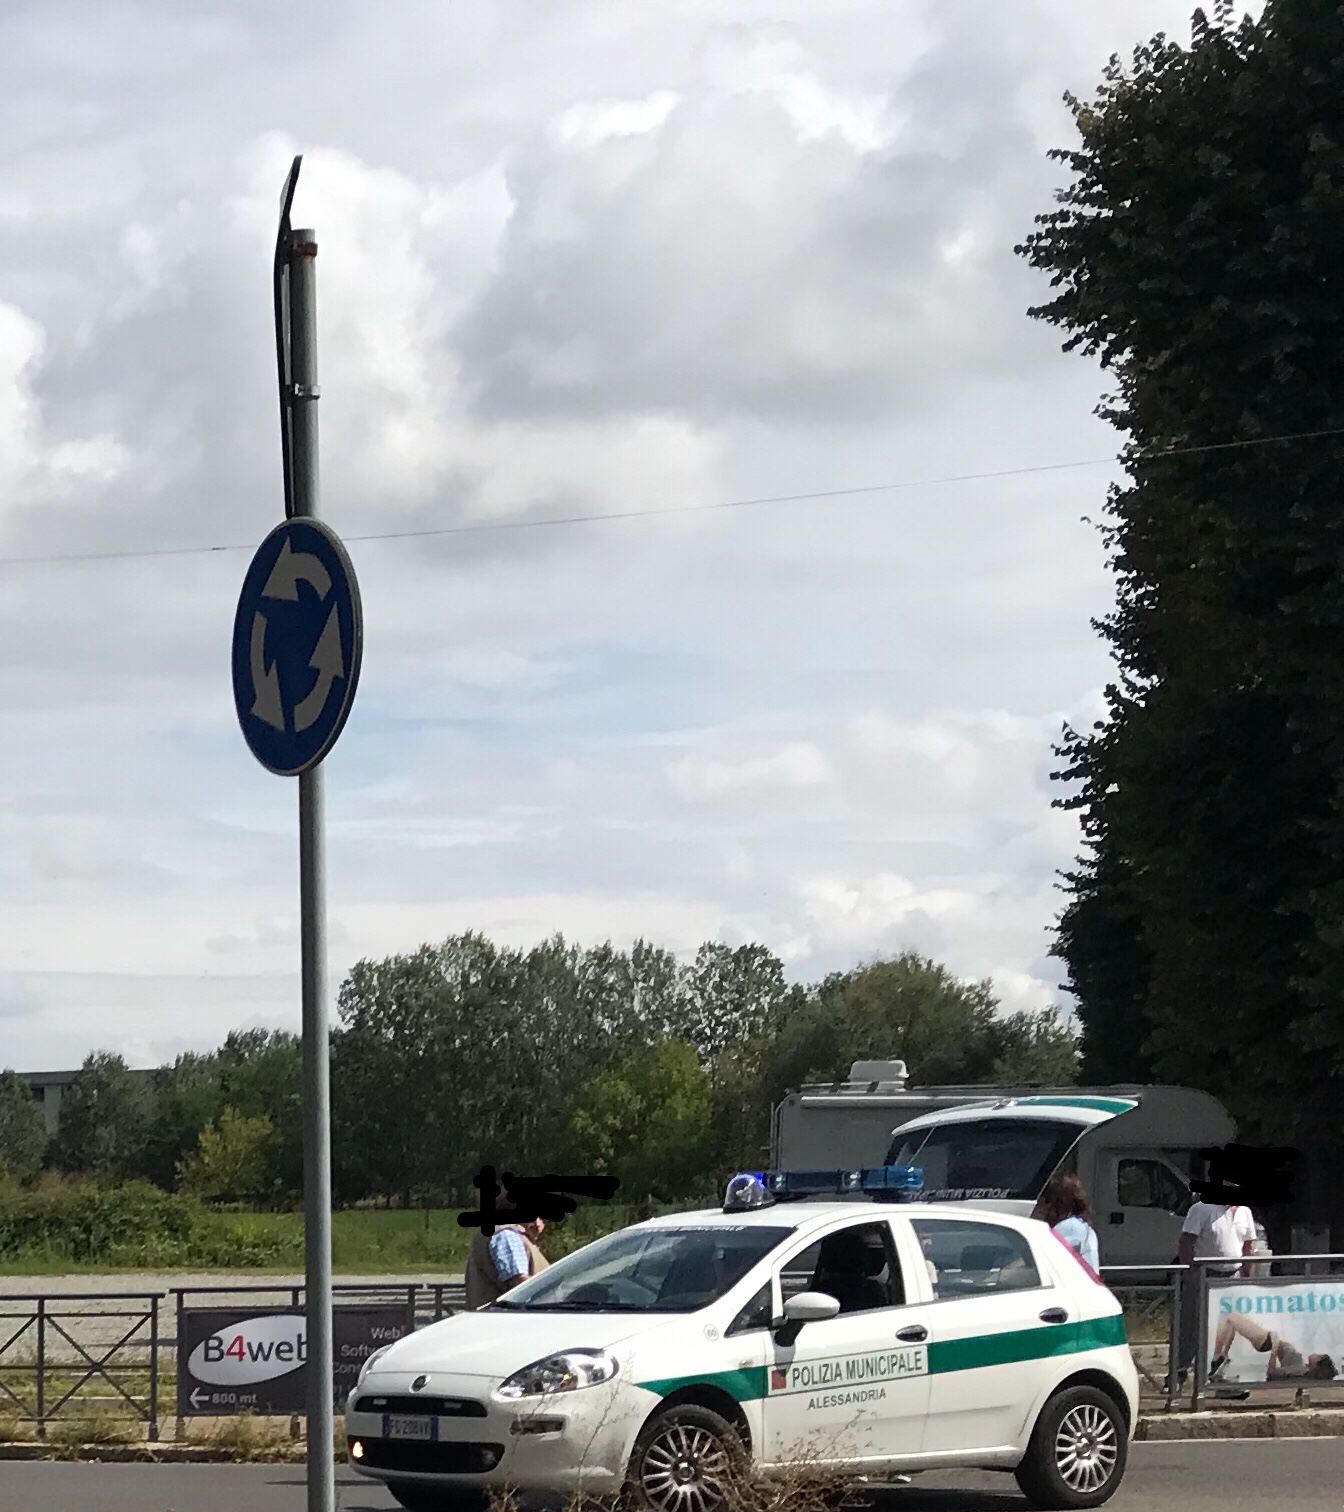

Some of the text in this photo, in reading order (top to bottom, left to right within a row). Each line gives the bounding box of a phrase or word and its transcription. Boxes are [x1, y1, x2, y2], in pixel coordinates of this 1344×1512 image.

[965, 1187, 1010, 1199] POLIZIA
[792, 1351, 923, 1388] POLIZIA MUNICIPALE
[212, 1392, 237, 1404] 800
[807, 1387, 887, 1411] ALESSANDRIA
